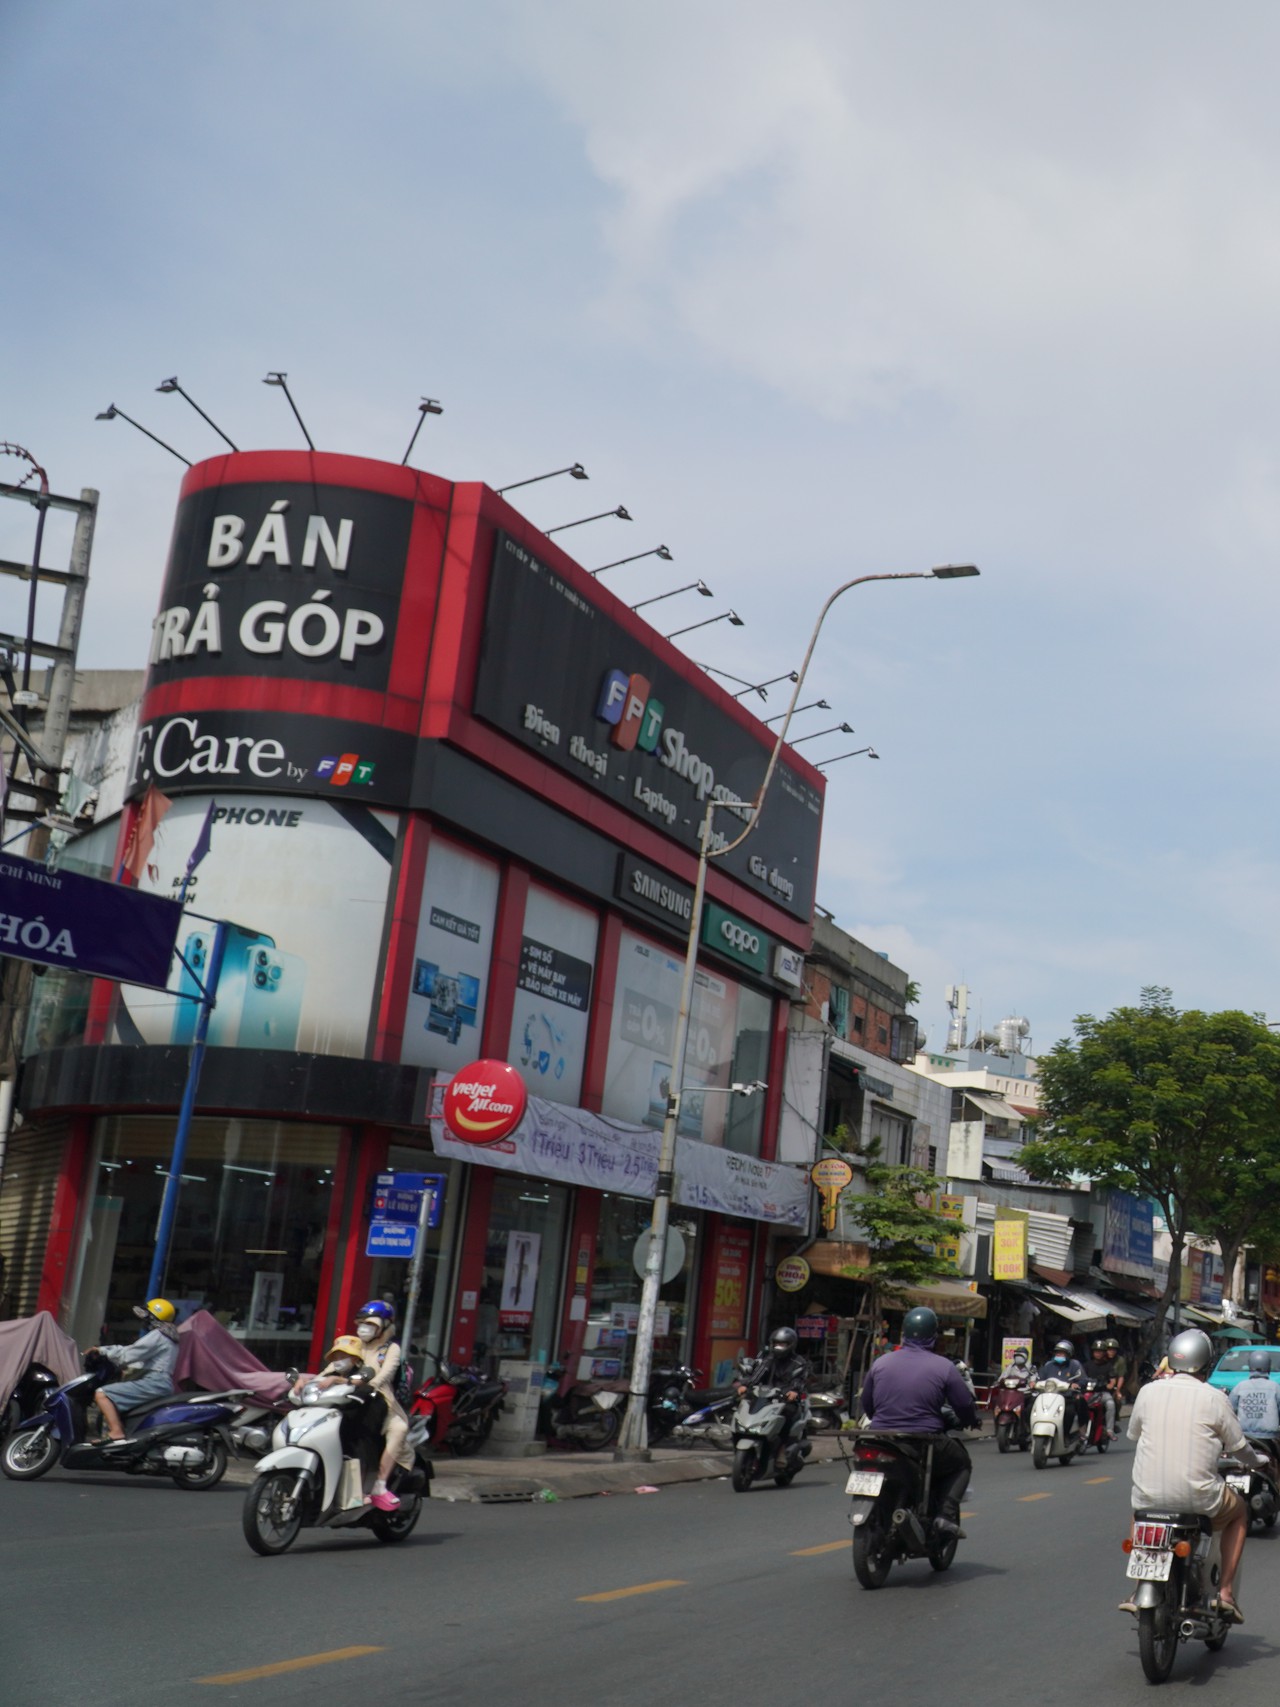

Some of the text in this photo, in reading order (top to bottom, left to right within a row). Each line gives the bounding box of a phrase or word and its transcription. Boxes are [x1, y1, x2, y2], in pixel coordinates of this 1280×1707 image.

[207, 501, 353, 571] BÁN
[151, 583, 384, 665] TRẢ GÓP
[602, 674, 663, 745] FPT
[130, 717, 376, 786] F.Care by FPT
[211, 807, 303, 828] PHONE
[634, 777, 677, 824] Laptop
[0, 863, 62, 890] CHÍ MINH
[634, 869, 691, 919] SAMSUNG
[0, 913, 77, 958] HÓA
[1144, 1552, 1158, 1564] 29
